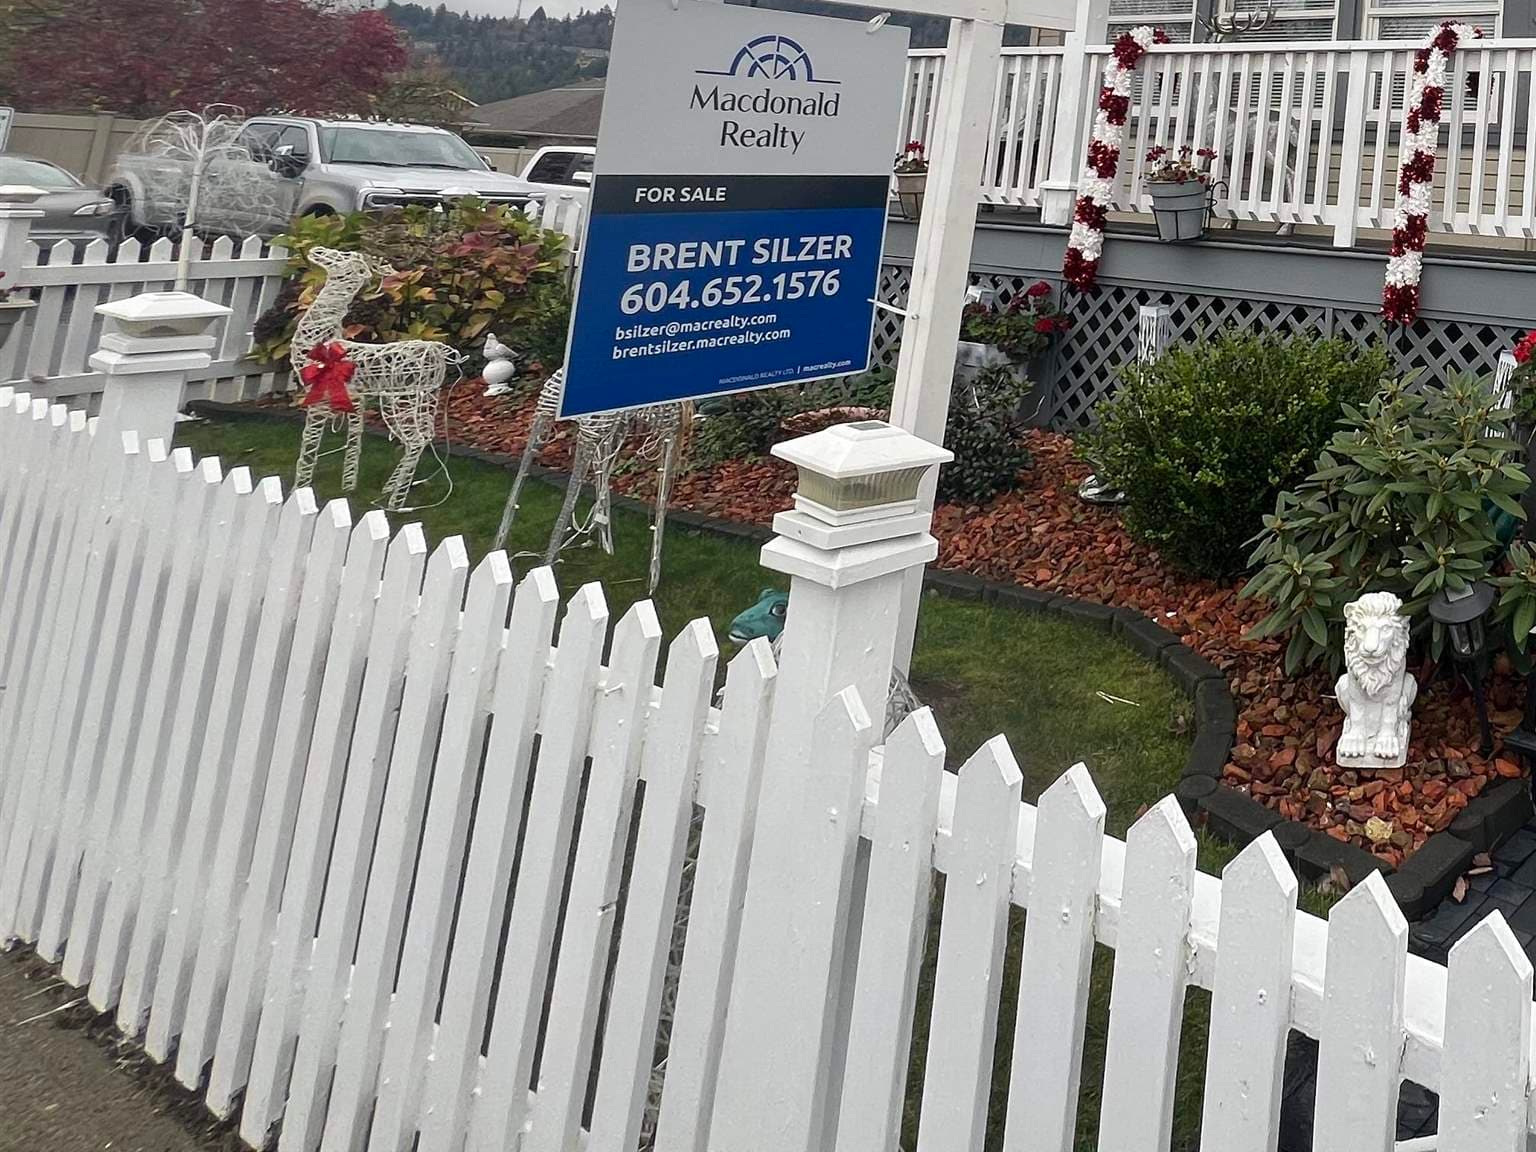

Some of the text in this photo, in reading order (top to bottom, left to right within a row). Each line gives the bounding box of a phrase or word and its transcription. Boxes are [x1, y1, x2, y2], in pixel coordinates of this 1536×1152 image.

[690, 84, 840, 117] Macdonald
[720, 120, 805, 155] Realty
[635, 187, 727, 203] FOR SALE
[626, 234, 853, 273] BRENT SILZER
[620, 268, 841, 315] 604.652.1576
[615, 313, 777, 341] bsilzer@macrealty.com
[612, 328, 791, 360] brentsilzer.macrealty.com
[803, 360, 852, 373] macrealty.com
